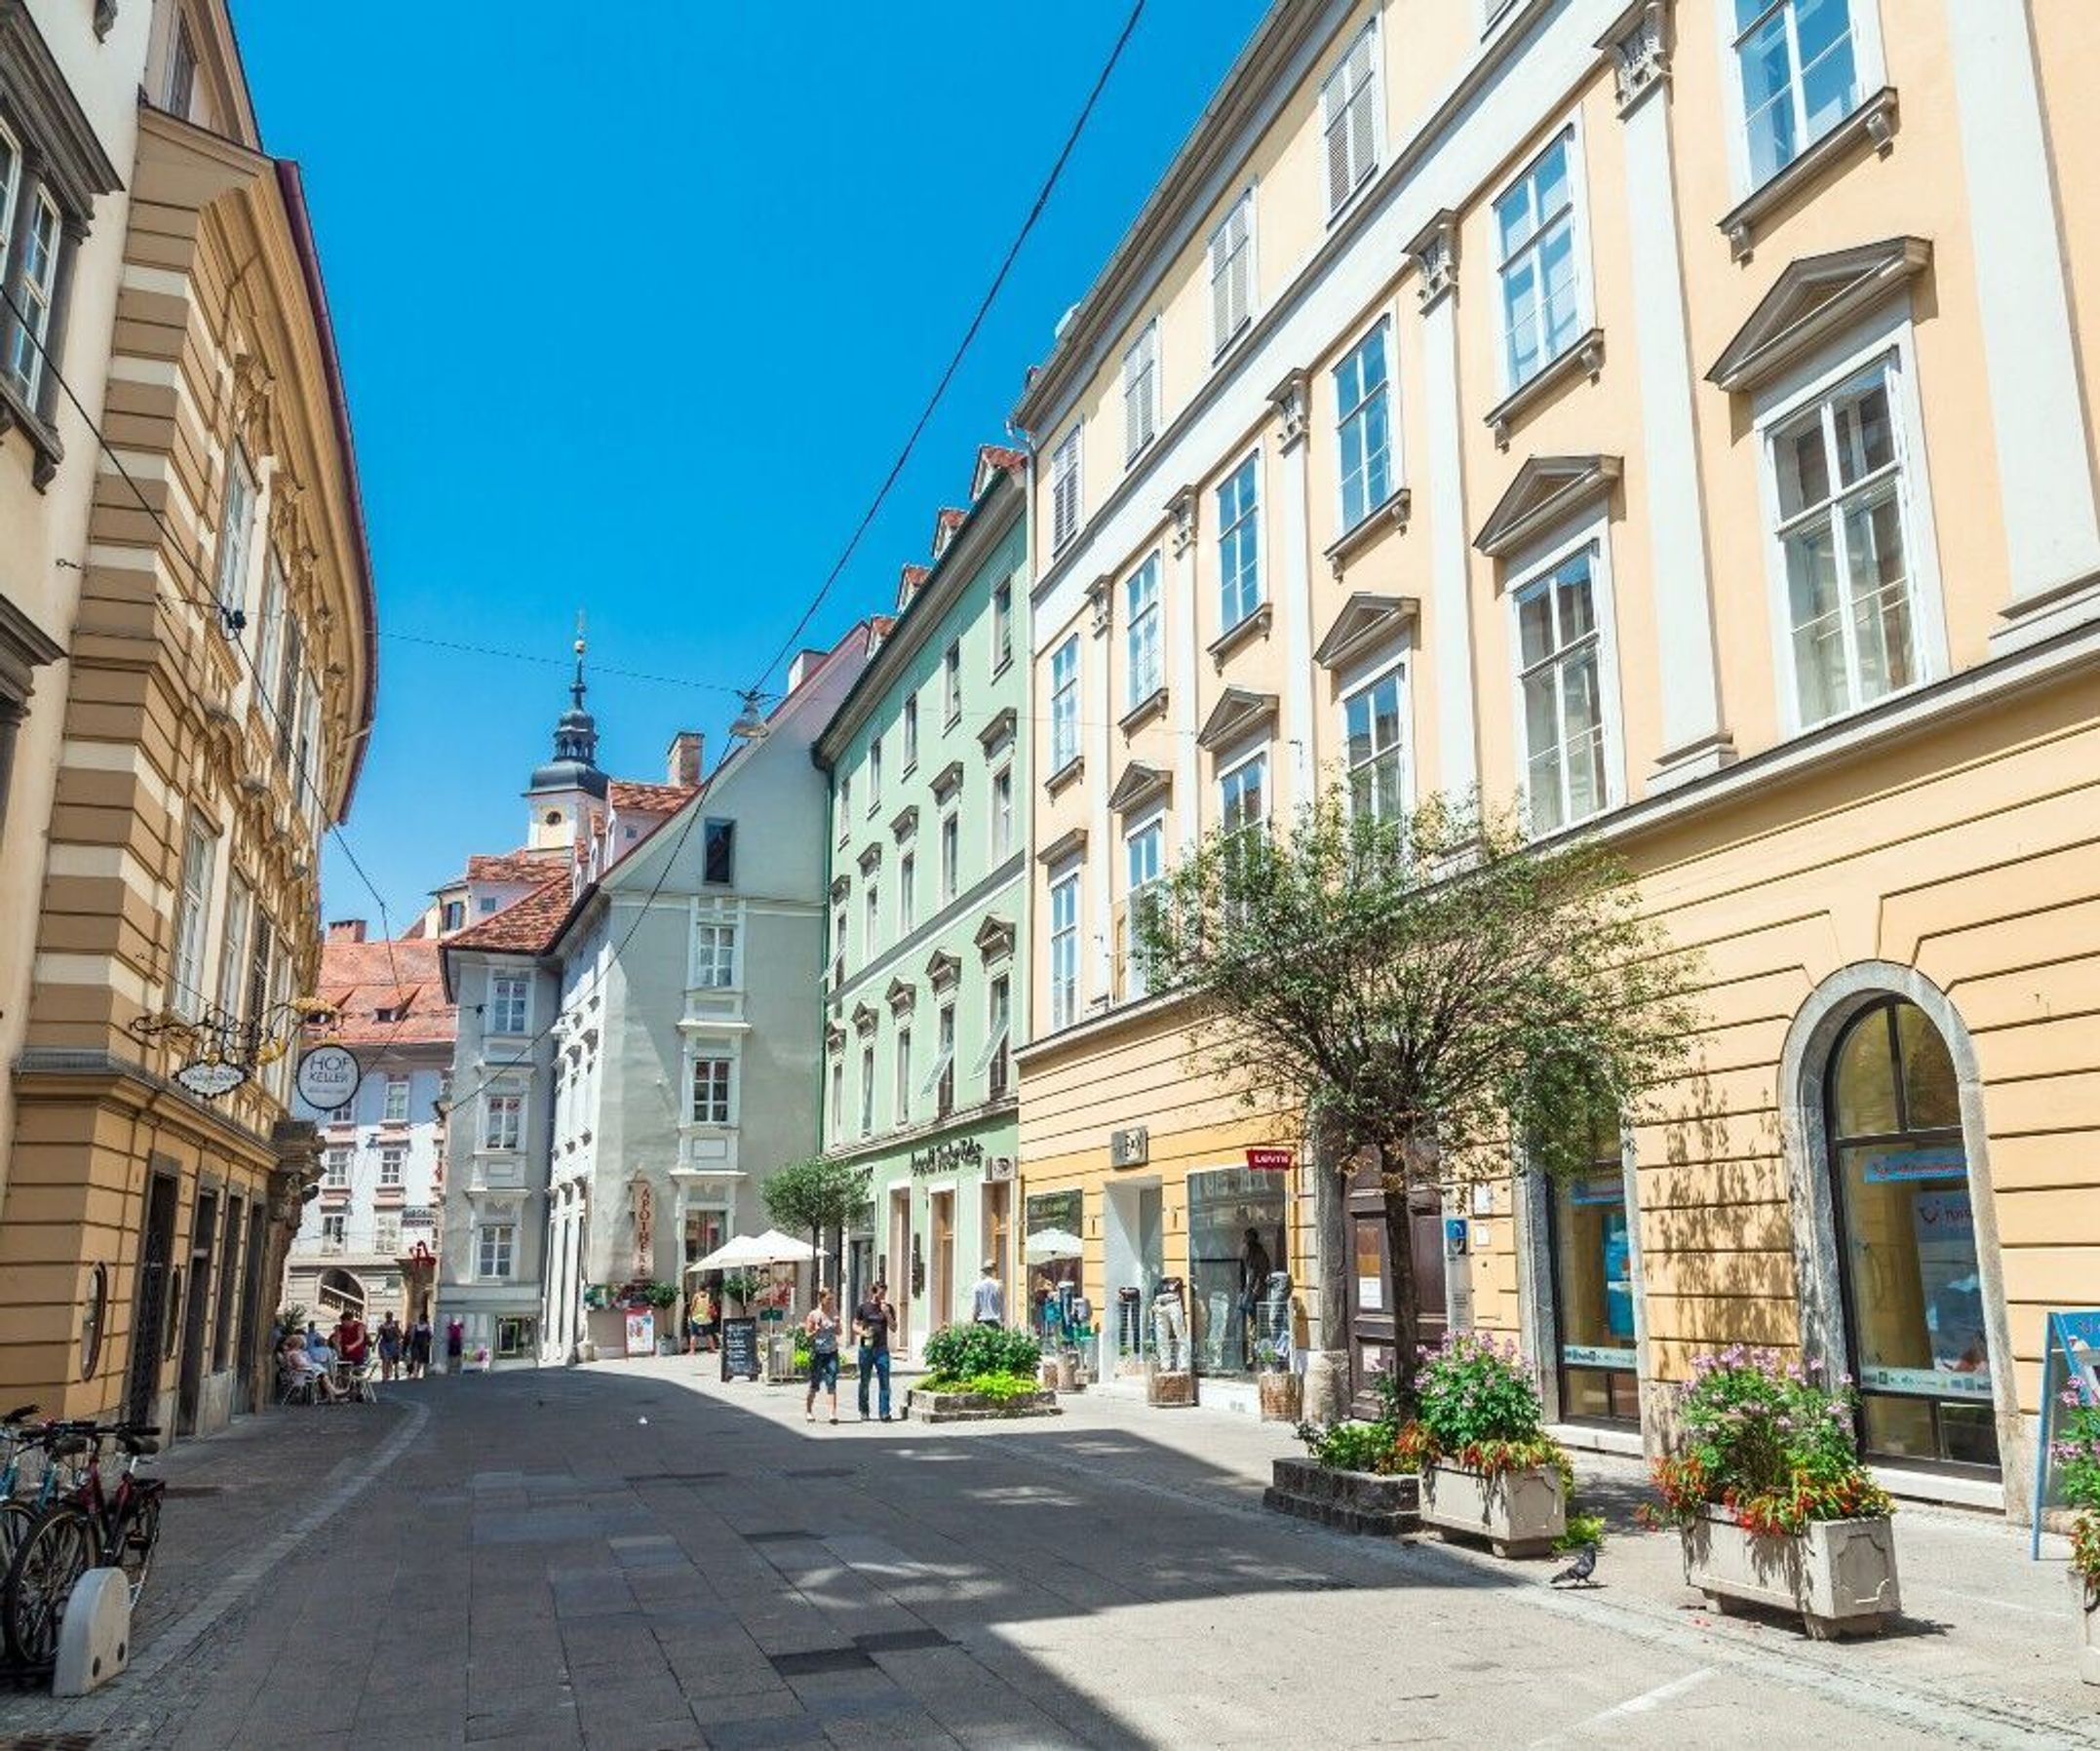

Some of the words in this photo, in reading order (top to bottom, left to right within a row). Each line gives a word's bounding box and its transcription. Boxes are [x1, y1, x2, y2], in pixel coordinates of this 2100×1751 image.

[310, 1055, 350, 1070] HOF
[309, 1071, 349, 1083] KELLER
[639, 1187, 650, 1276] APOTHEKE
